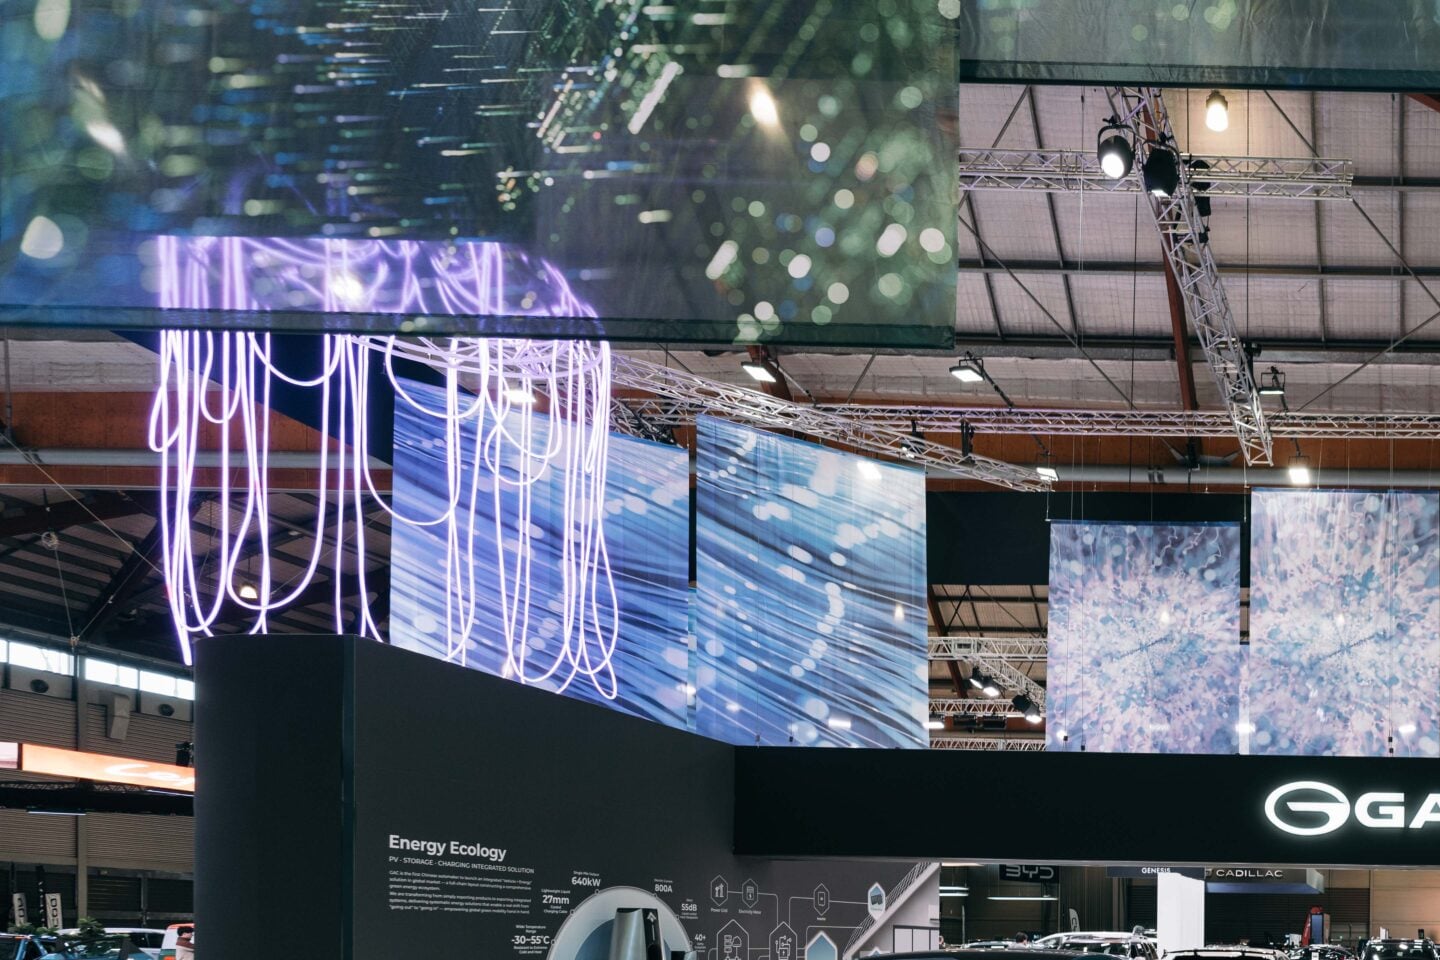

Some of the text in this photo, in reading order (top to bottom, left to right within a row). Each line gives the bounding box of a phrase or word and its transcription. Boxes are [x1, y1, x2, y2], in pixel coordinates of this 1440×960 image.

[389, 834, 507, 862] Energy Ecology
[403, 857, 434, 866] STORAGE
[438, 860, 470, 869] CHARGING
[472, 863, 507, 872] INTEGRATED
[507, 866, 534, 874] SOLUTION
[1006, 865, 1054, 880] BYD
[1216, 868, 1283, 878] CADILLAC
[571, 877, 600, 886] 640kW
[655, 884, 672, 893] 800A
[542, 895, 569, 904] 27mm
[681, 903, 697, 911] 55dB
